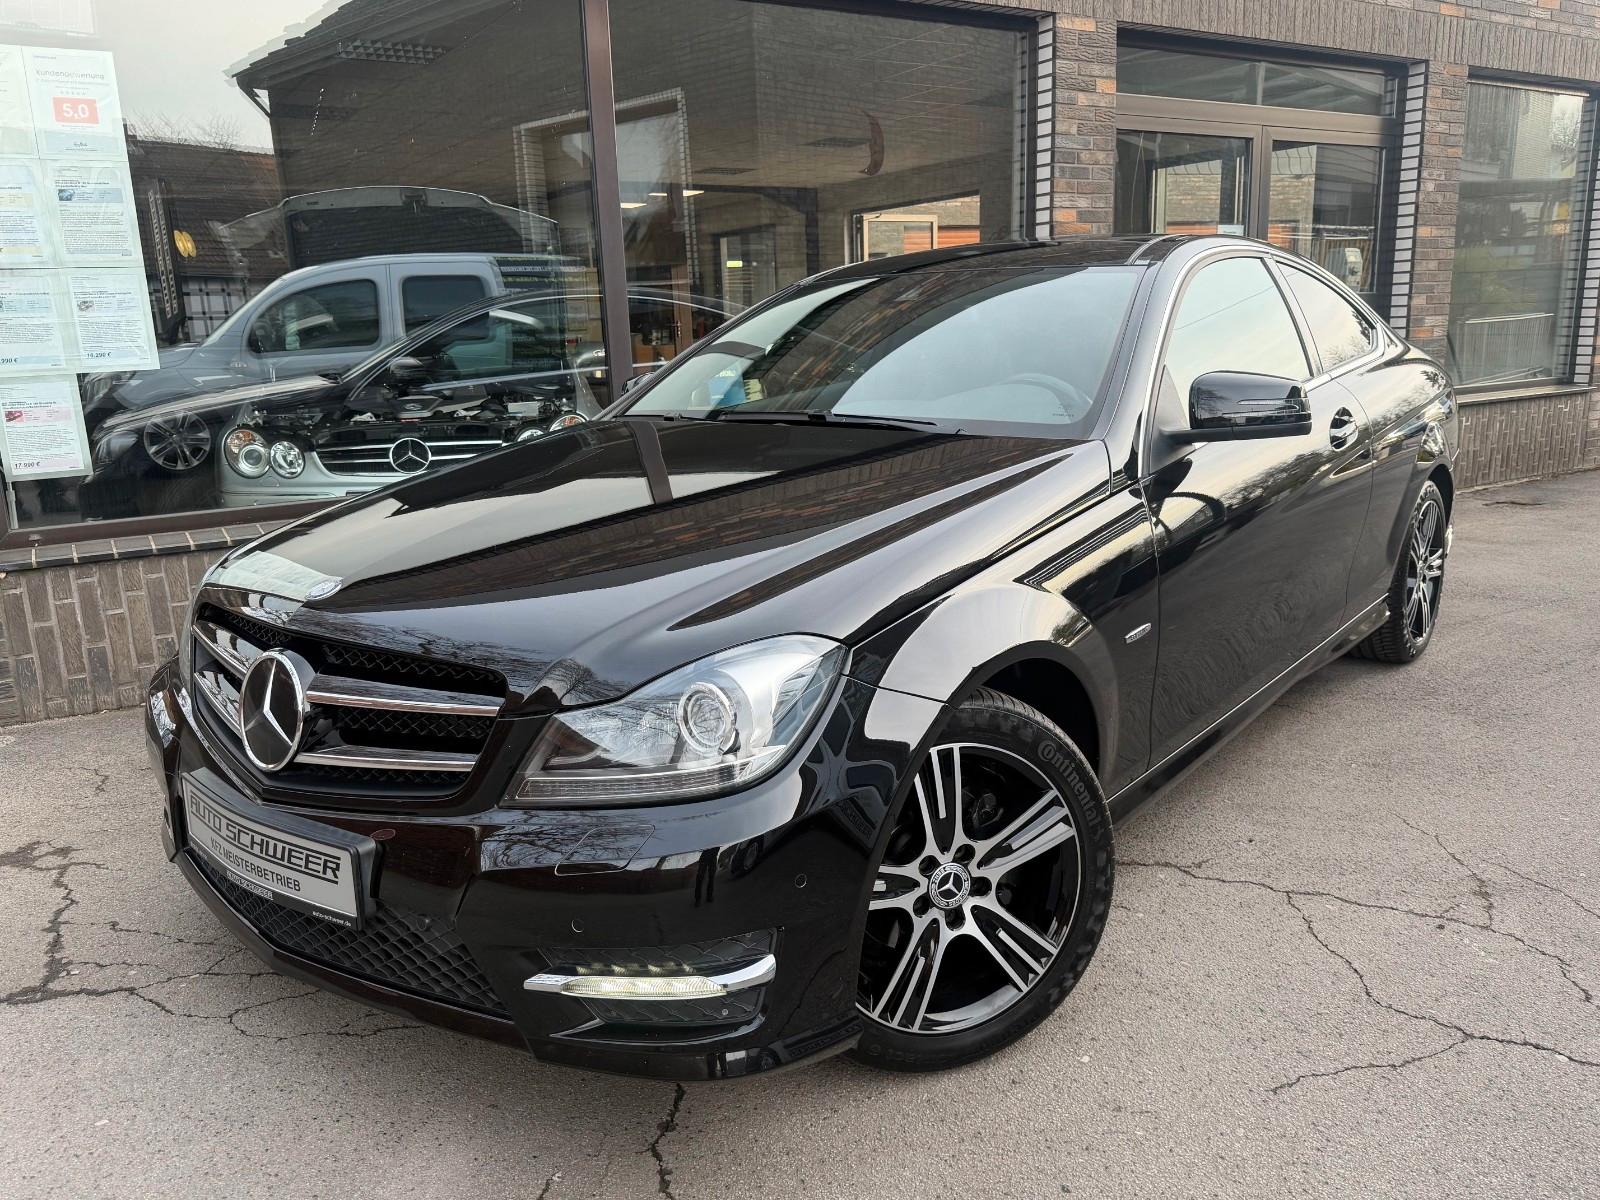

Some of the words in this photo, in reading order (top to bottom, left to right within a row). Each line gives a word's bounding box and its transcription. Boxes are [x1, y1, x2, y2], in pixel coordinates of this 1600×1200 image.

[1038, 740, 1103, 826] Continental
[190, 794, 222, 833] AUTO
[226, 822, 341, 880] SCHWEER
[223, 845, 301, 892] MEISTERBETRIEB
